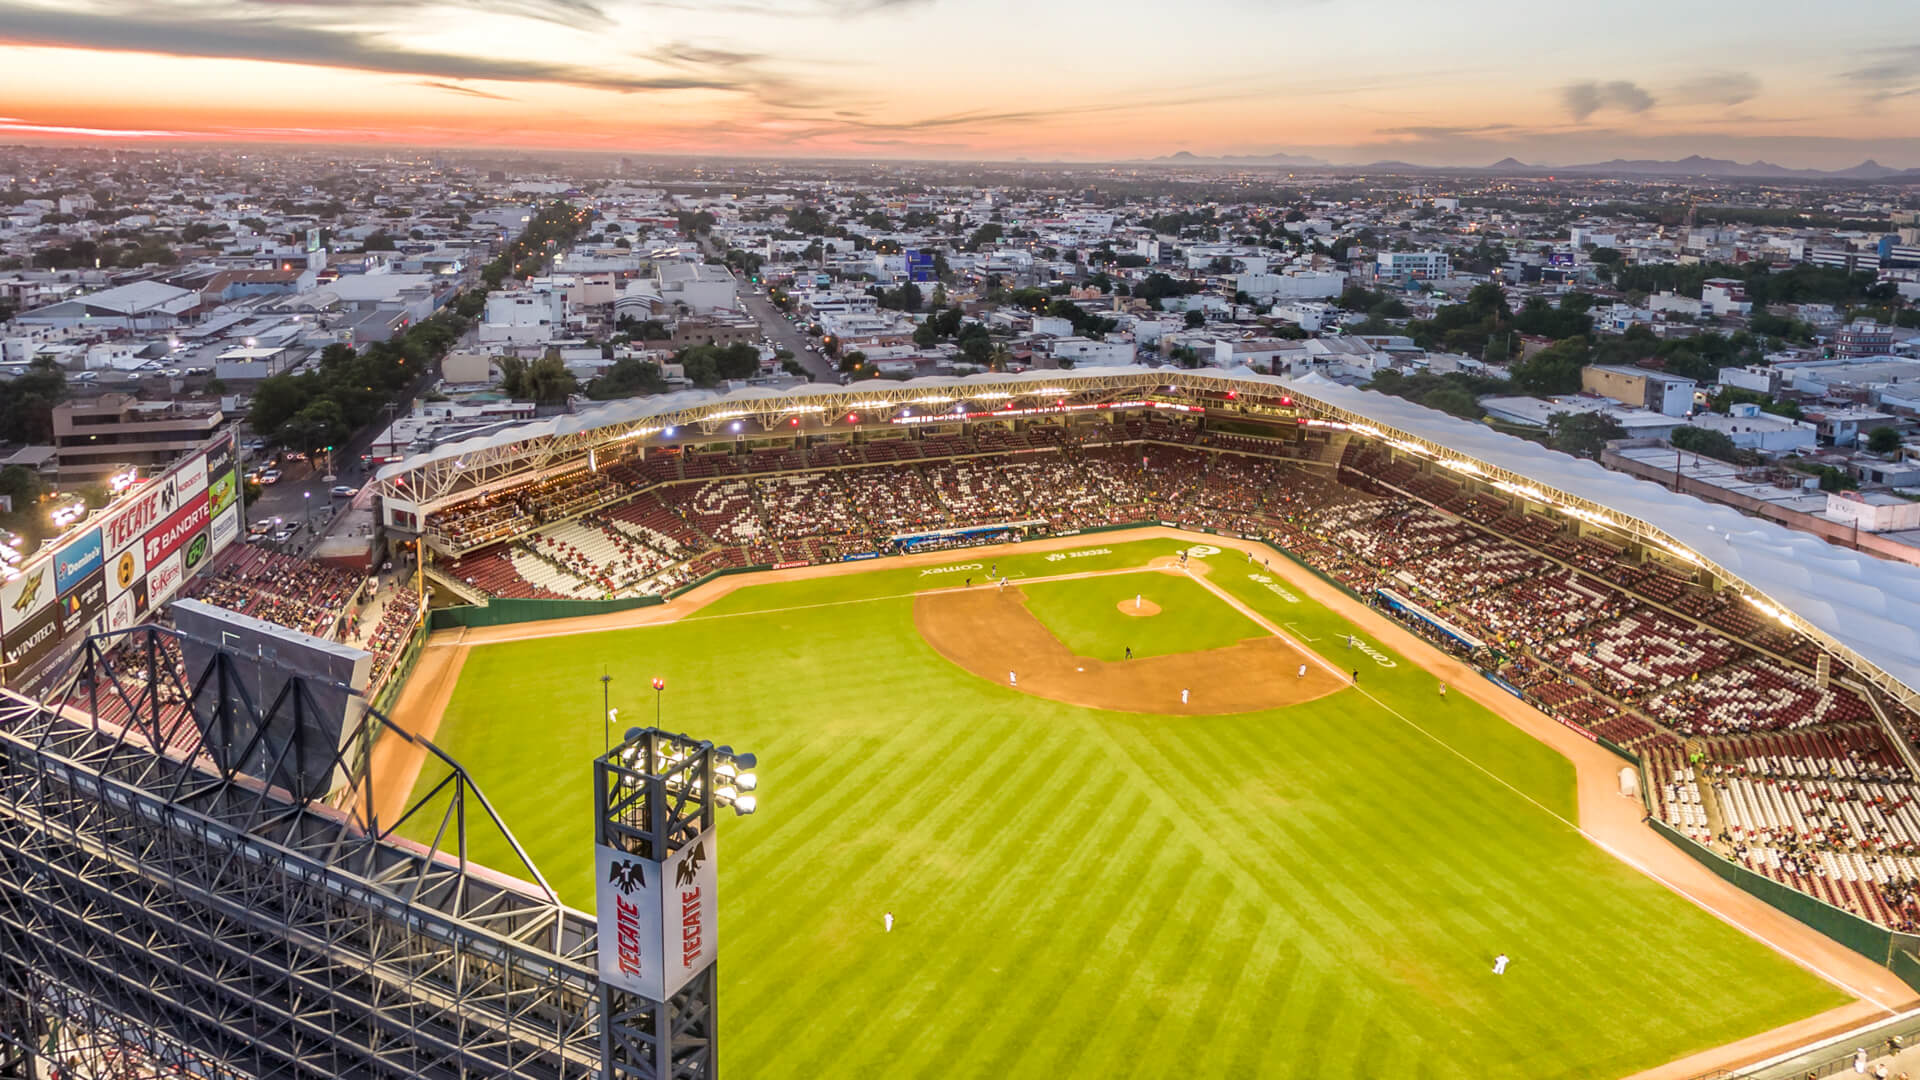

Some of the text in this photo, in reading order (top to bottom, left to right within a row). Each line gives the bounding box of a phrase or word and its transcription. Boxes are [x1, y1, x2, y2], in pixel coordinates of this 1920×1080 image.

[107, 491, 159, 550] TECATE
[161, 501, 209, 550] BANORTE
[920, 563, 983, 577] Comex
[16, 621, 57, 657] VINOTECA
[617, 894, 642, 979] TECATE
[682, 886, 703, 968] TECATE
